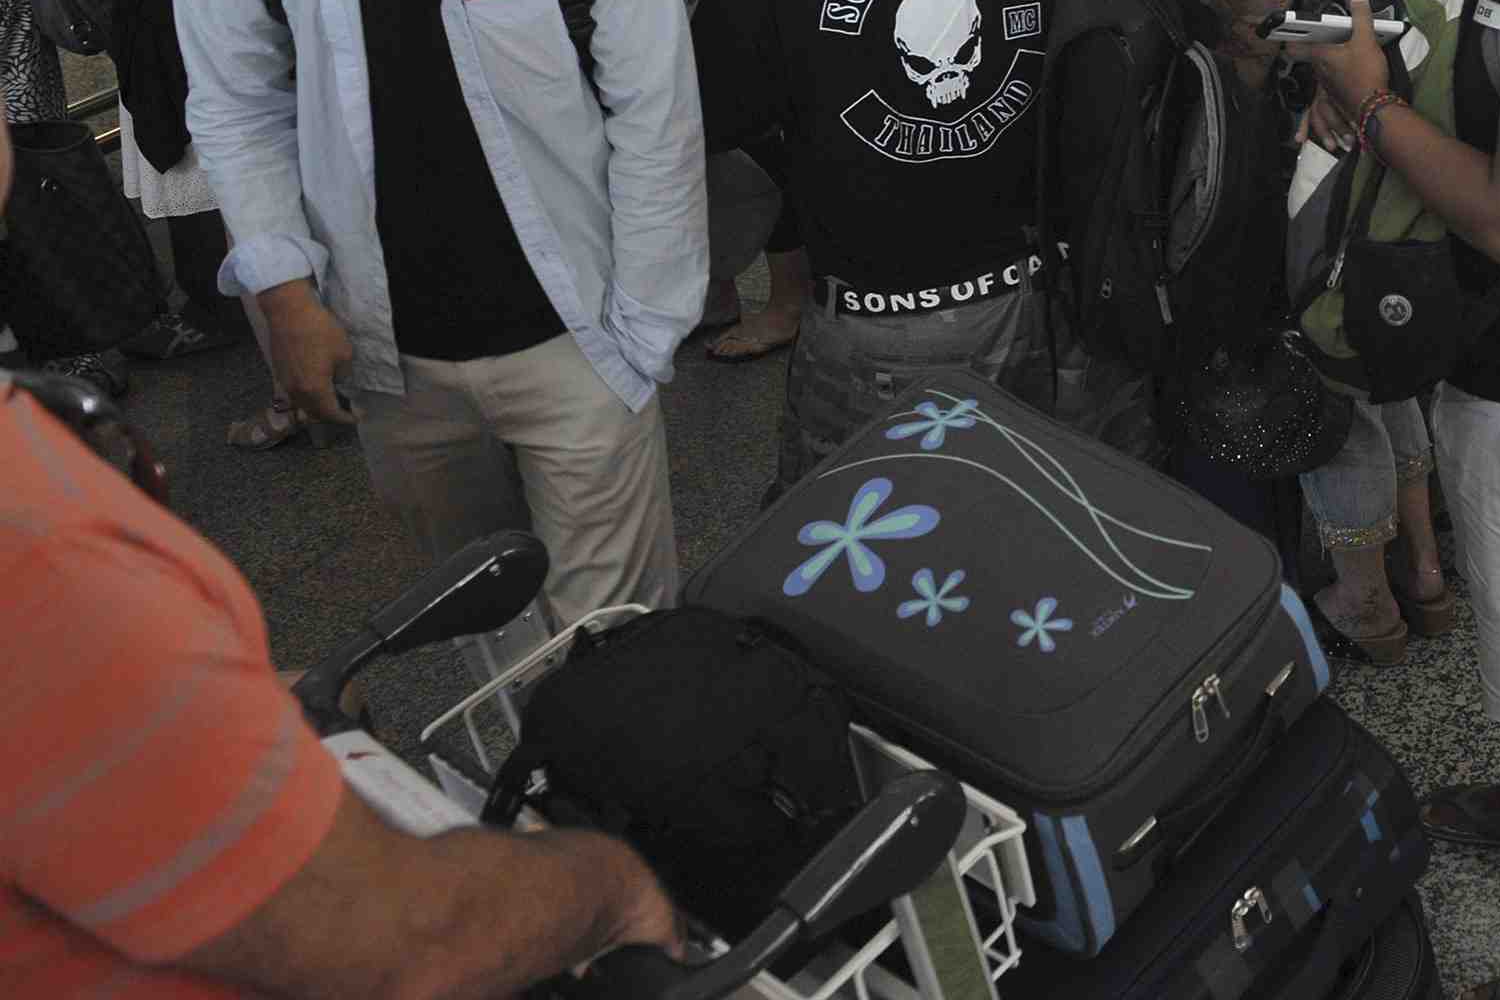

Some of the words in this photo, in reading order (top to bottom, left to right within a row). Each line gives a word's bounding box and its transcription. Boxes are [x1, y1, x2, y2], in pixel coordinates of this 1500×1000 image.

[1009, 8, 1036, 35] MC
[874, 79, 1033, 156] THAILAND
[843, 288, 942, 313] SONS
